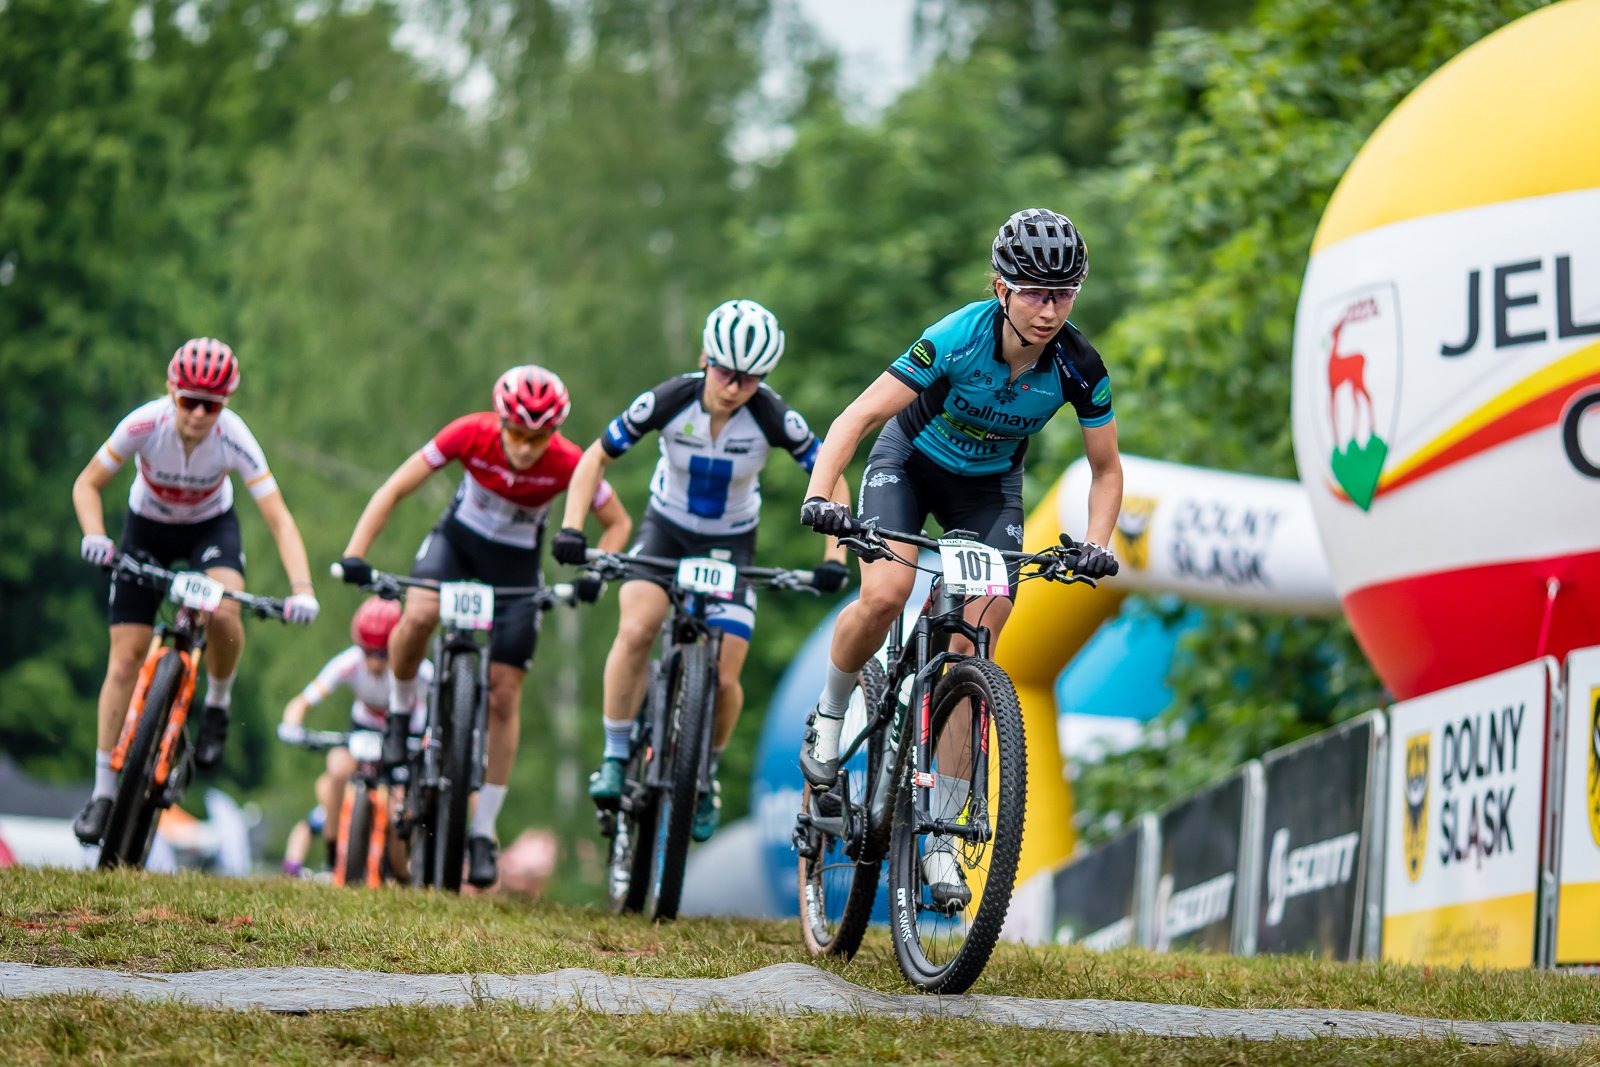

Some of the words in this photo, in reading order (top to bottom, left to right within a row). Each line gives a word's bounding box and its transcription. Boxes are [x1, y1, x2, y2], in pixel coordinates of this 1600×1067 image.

[953, 395, 1043, 430] Dallmayr
[693, 566, 721, 586] 110
[955, 550, 991, 581] 107
[454, 592, 482, 615] 109
[1442, 702, 1525, 786] DOLNY
[1282, 831, 1360, 899] SCOTT
[896, 887, 907, 908] DT
[899, 909, 913, 943] SWISS
